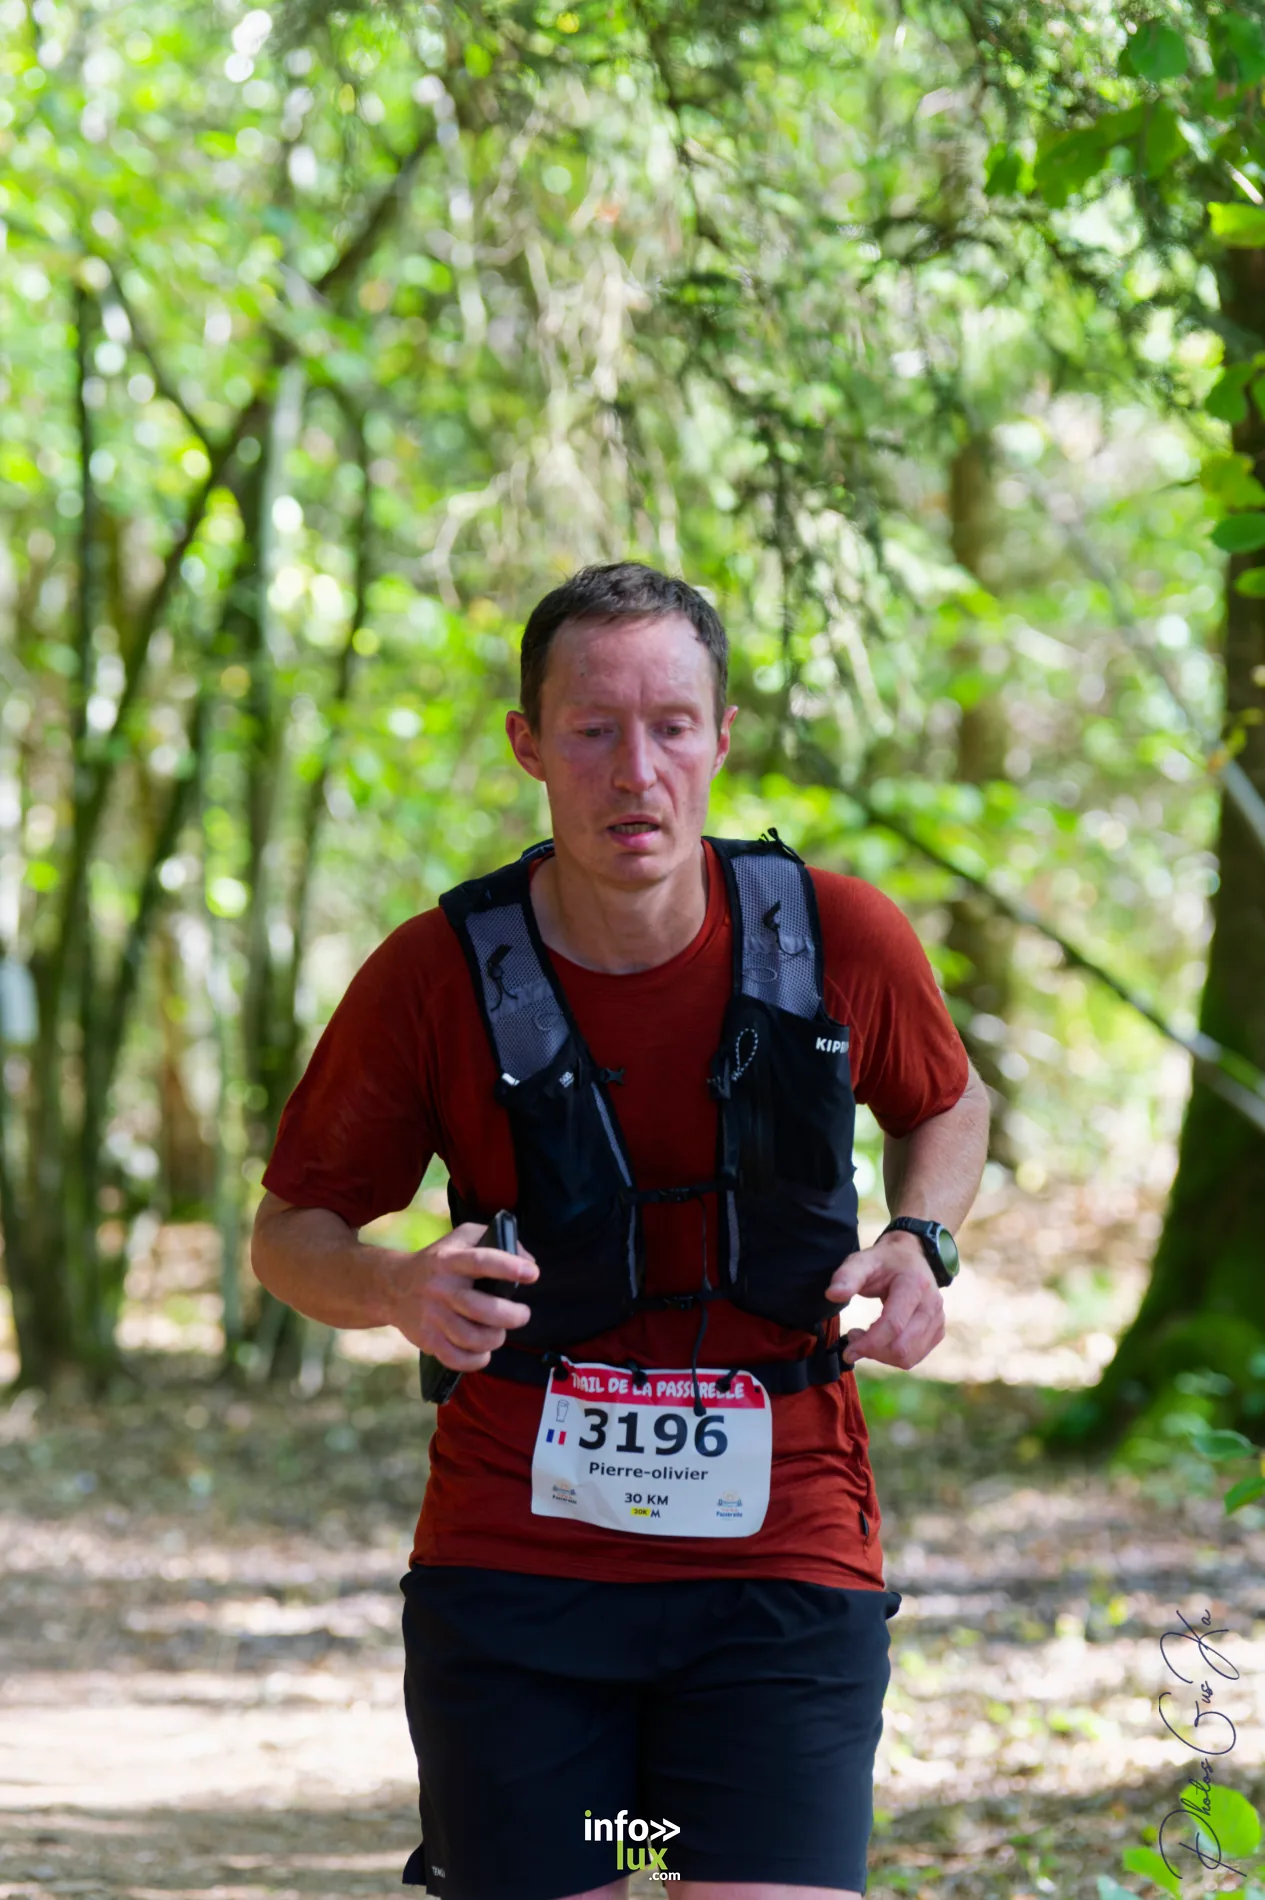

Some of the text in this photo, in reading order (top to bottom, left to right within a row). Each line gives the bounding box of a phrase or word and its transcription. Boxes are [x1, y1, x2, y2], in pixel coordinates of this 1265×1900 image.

[608, 1377, 629, 1394] DE
[579, 1407, 729, 1458] 3196
[588, 1461, 709, 1481] Pierre-olivier
[624, 1492, 669, 1506] 30 KM
